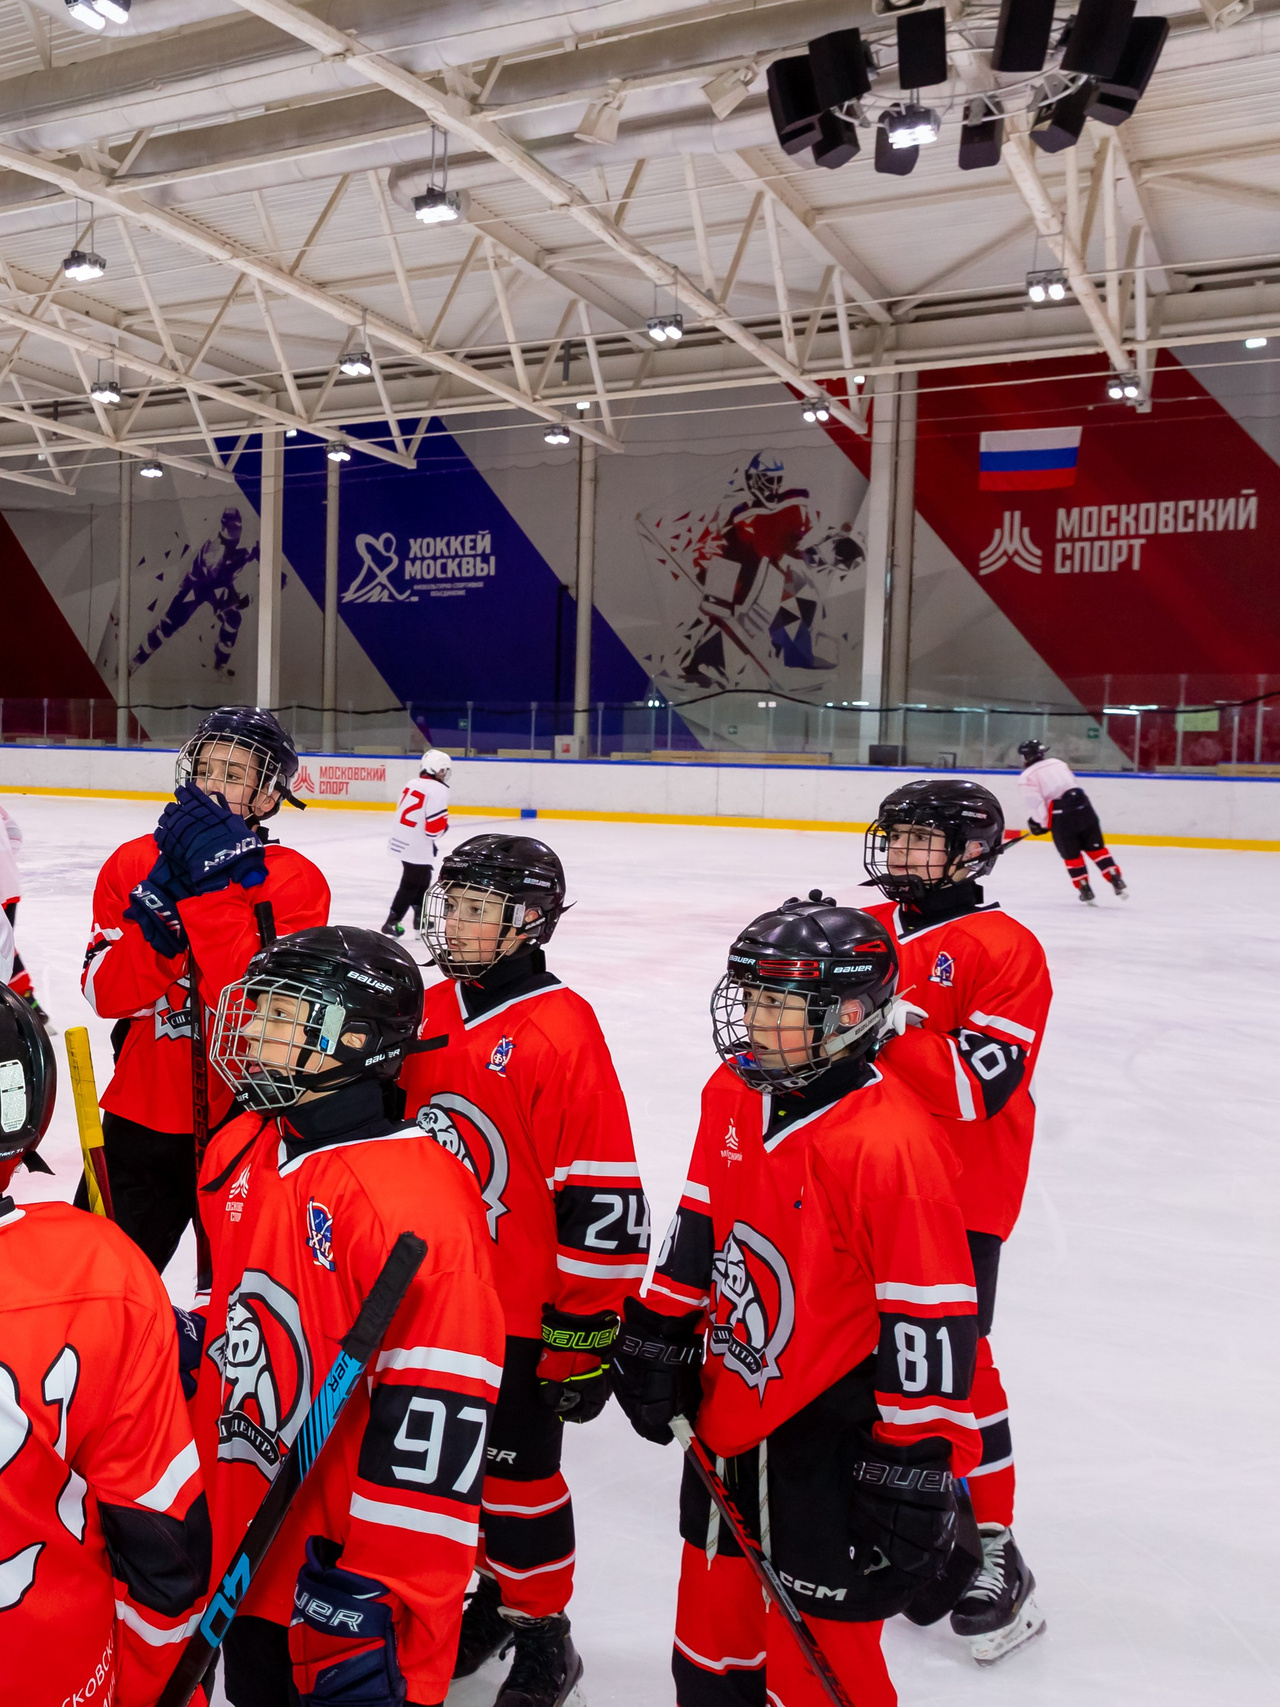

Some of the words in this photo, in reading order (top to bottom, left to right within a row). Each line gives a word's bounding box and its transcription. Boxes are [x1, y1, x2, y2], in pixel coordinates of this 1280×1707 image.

[1056, 489, 1258, 539] МОСКОВСКИЙ
[408, 530, 492, 558] ХОККЕЙ
[1054, 538, 1147, 574] СПОРТ
[404, 555, 496, 580] МОСКВЫ
[320, 764, 386, 782] МОСКОВСКИЙ
[319, 781, 350, 795] СПОРТ
[729, 954, 756, 966] BAUER
[833, 964, 872, 974] BAUER
[347, 970, 395, 995] BAUER
[365, 1048, 401, 1067] BAUER
[584, 1194, 652, 1249] 24
[894, 1322, 953, 1394] 81
[391, 1396, 487, 1494] 97
[779, 1570, 848, 1602] CCM
